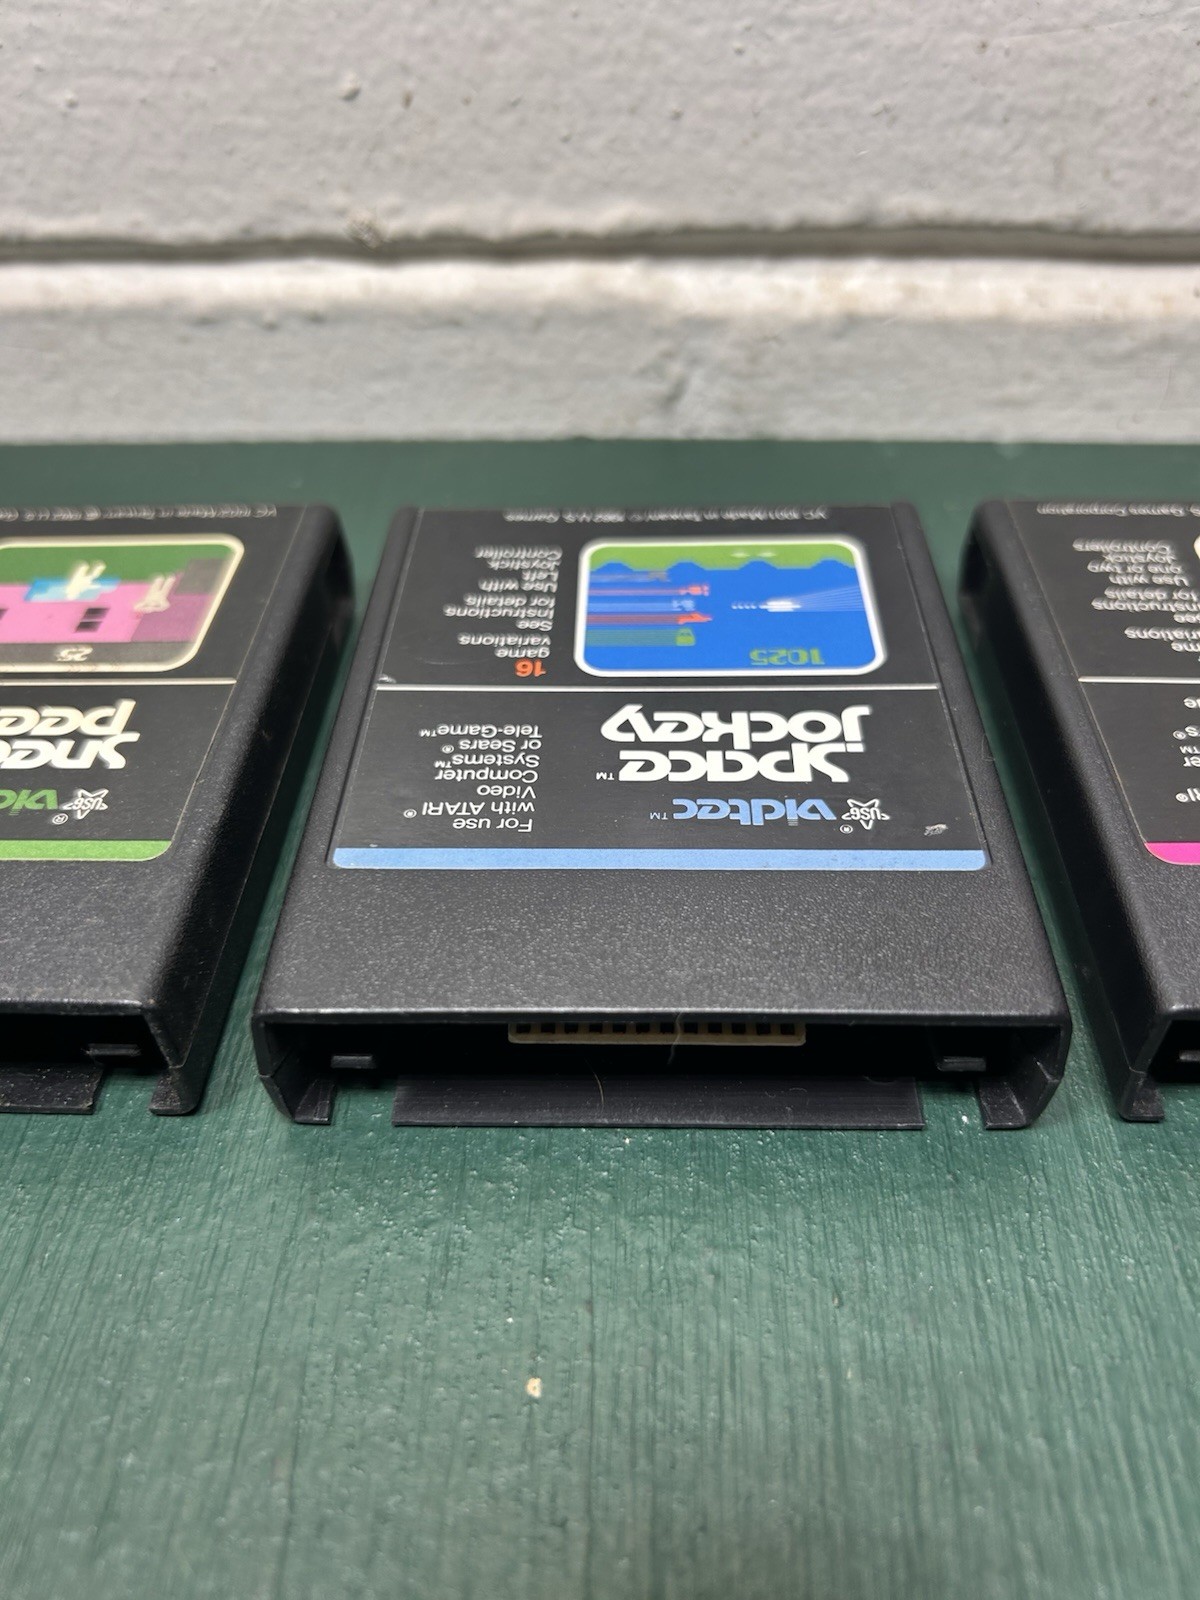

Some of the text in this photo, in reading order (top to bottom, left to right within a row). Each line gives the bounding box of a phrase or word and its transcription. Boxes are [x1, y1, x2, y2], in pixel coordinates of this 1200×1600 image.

[486, 558, 562, 570] Joystick
[521, 569, 560, 581] Left
[477, 578, 558, 593] Use with
[463, 593, 556, 608] for details
[442, 603, 555, 619] Instructions
[515, 618, 554, 632] See
[457, 632, 552, 647] variations
[493, 646, 551, 659] game
[749, 648, 826, 666] 1025
[514, 659, 547, 678] 16
[520, 739, 542, 750] or
[434, 767, 538, 783] Computer
[476, 784, 536, 799] Video
[490, 801, 535, 815] with
[452, 818, 533, 832] For use
